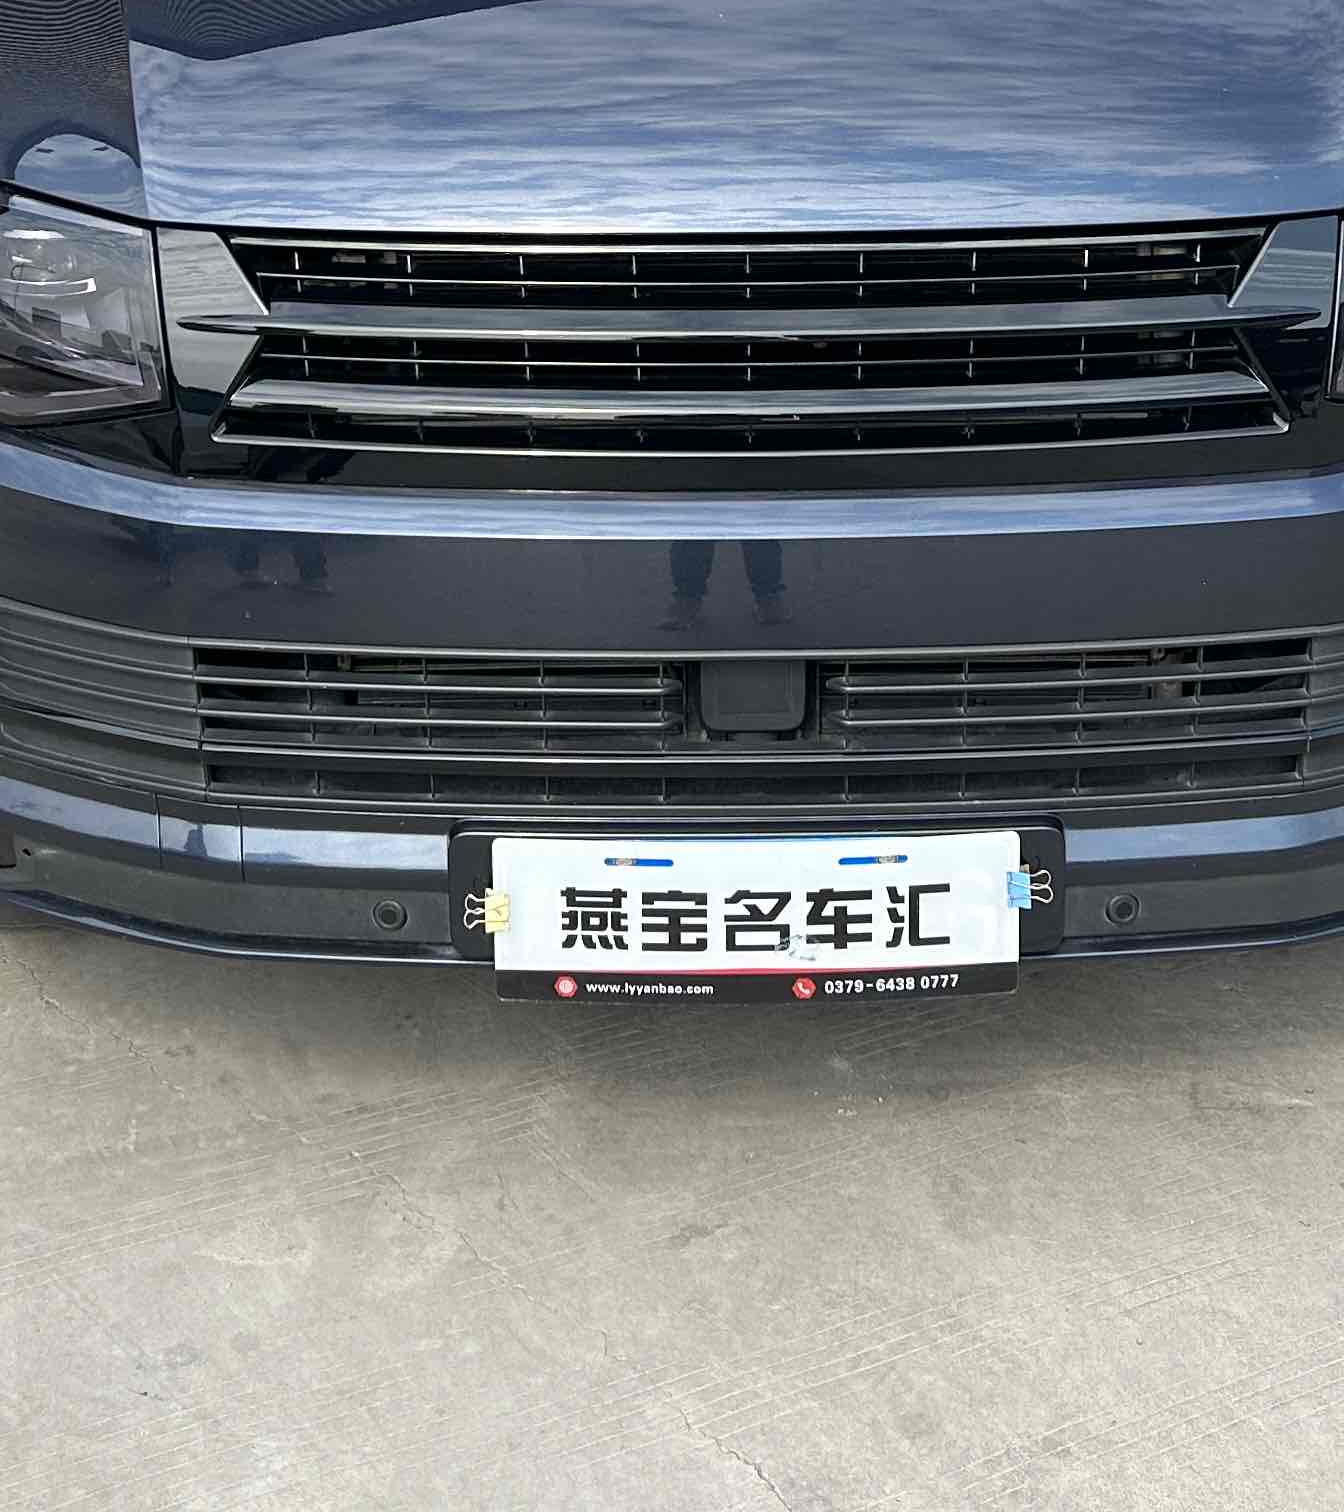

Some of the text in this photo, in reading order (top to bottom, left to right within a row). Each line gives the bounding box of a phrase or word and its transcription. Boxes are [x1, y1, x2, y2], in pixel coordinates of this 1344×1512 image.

[560, 883, 950, 952] 燕宝名车汇
[585, 981, 714, 995] www.lyyanbao.com
[824, 974, 959, 994] 0379-6438 0777
